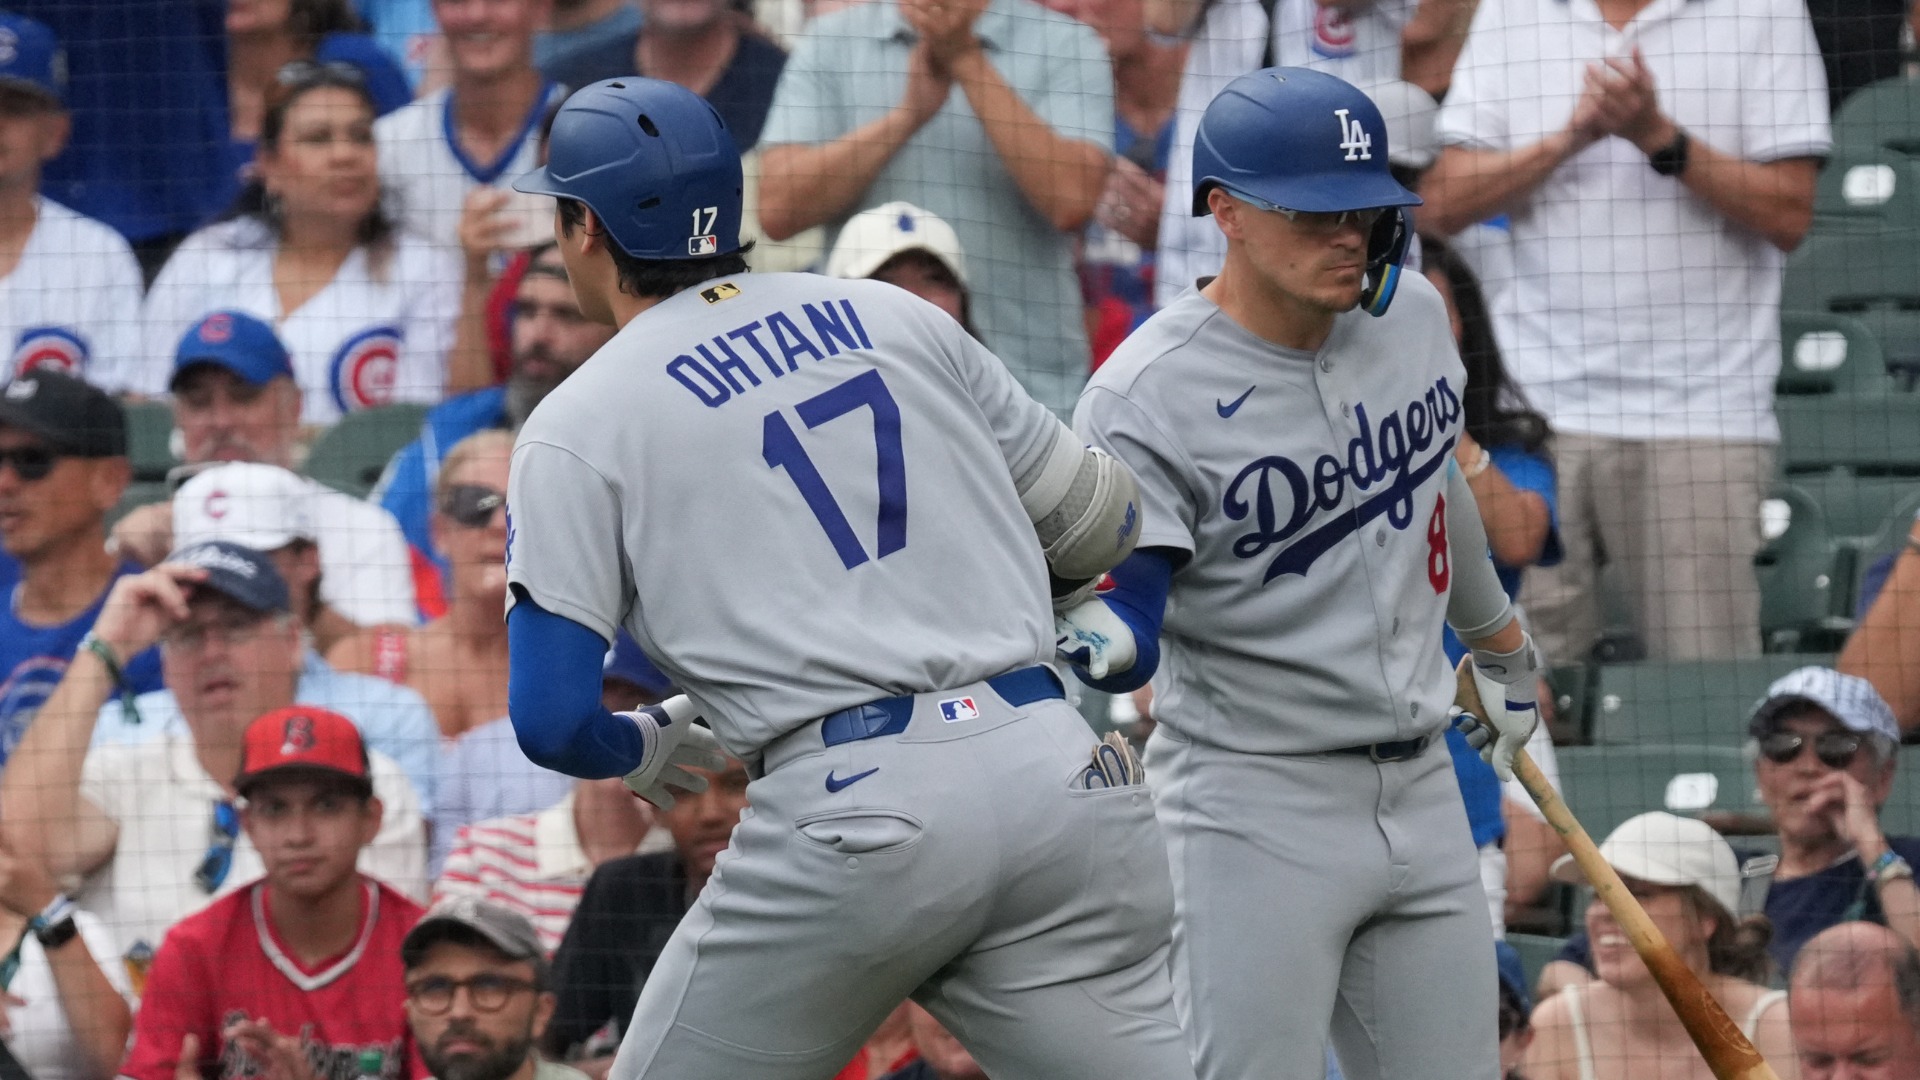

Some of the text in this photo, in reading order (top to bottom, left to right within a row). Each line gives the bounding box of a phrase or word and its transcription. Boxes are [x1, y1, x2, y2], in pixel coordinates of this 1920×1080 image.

[1334, 108, 1371, 161] LA
[692, 206, 718, 236] 17
[666, 299, 874, 408] OHTANI
[762, 368, 907, 571] 17
[1223, 376, 1461, 560] Dodgers
[1428, 491, 1449, 596] 8
